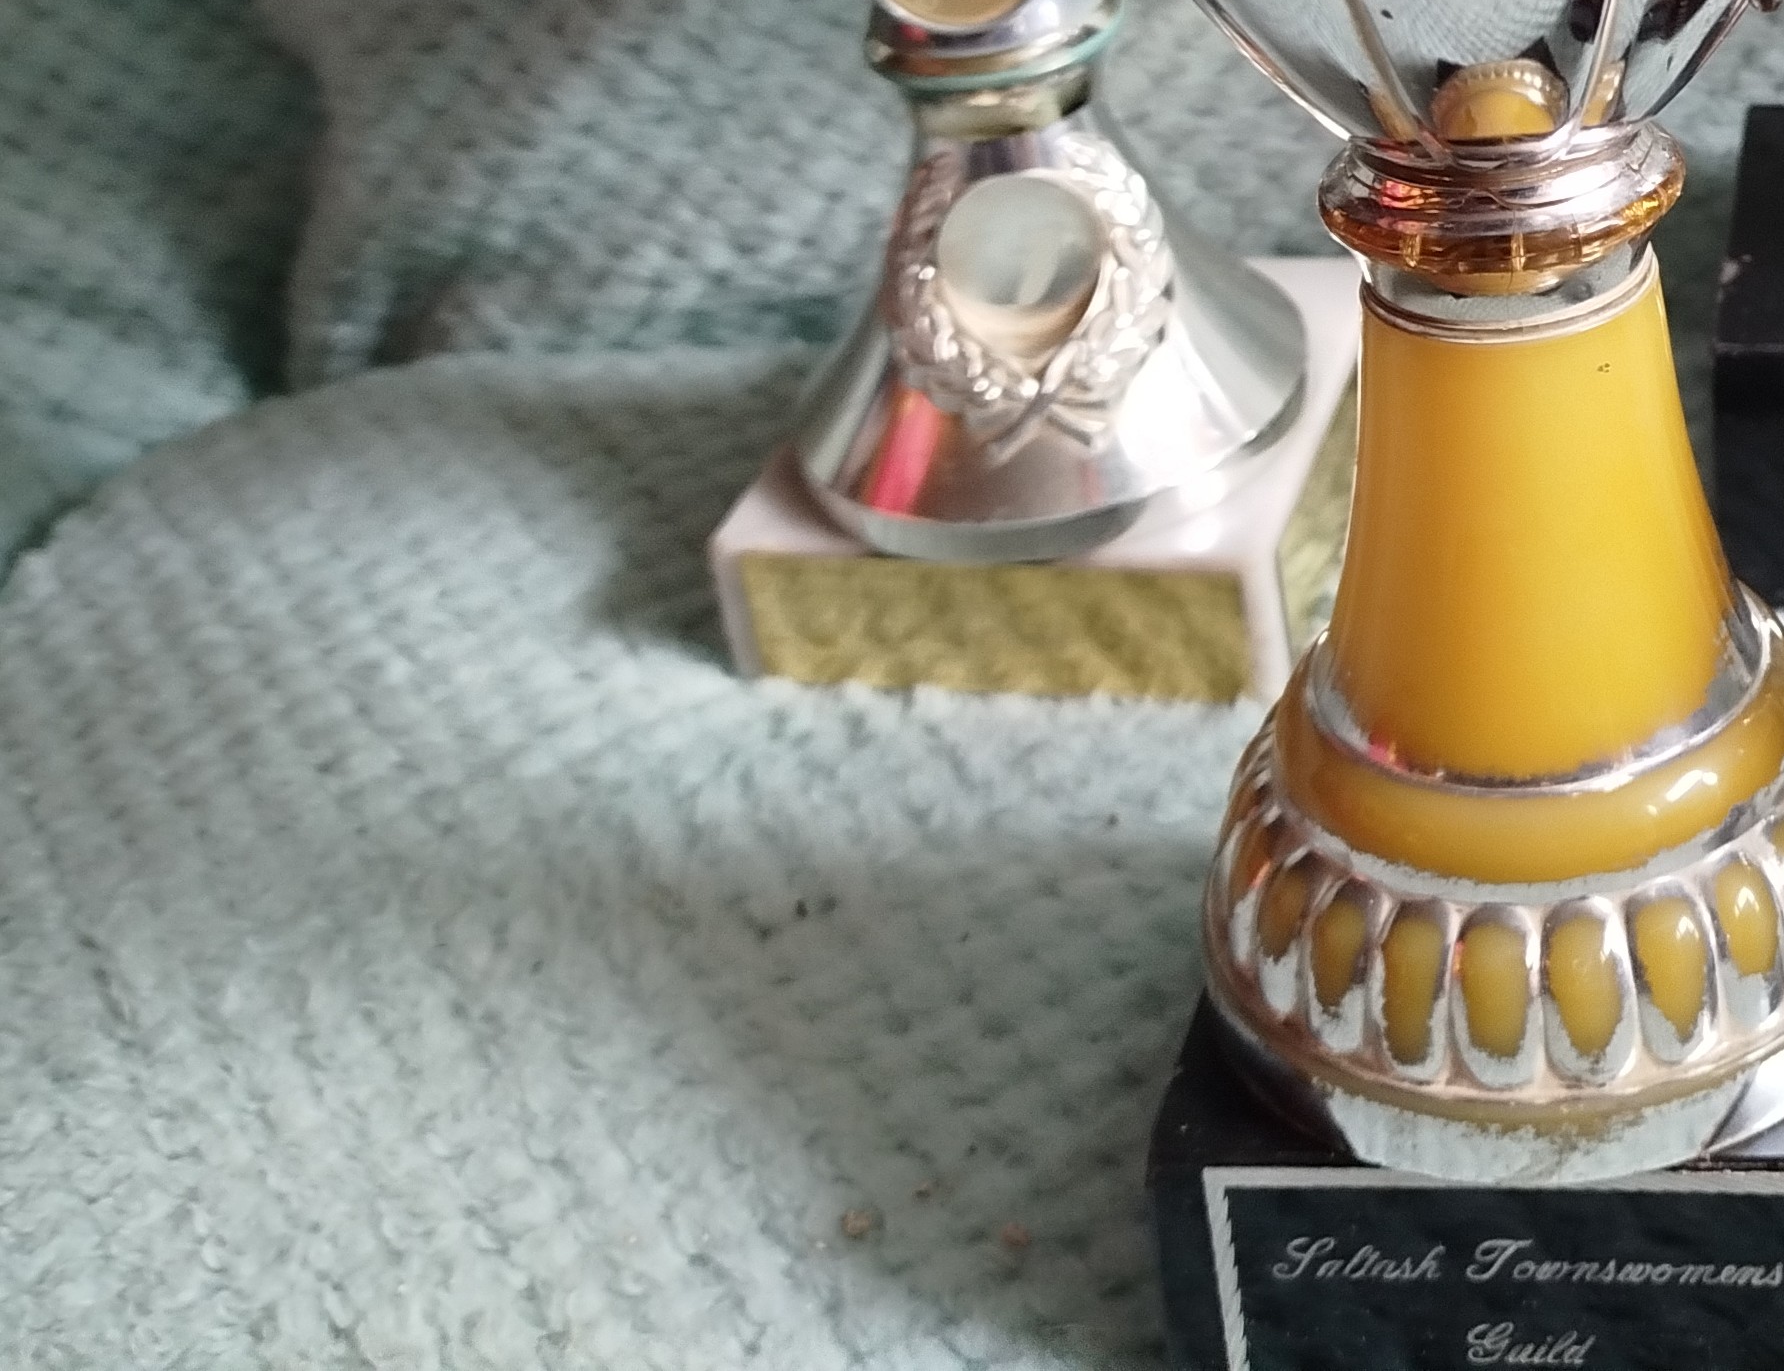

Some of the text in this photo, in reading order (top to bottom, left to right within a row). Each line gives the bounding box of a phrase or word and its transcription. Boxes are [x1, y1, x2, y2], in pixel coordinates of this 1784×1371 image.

[1272, 1236, 1784, 1287] Saltash Townswomens
[1467, 1322, 1596, 1365] Guild
